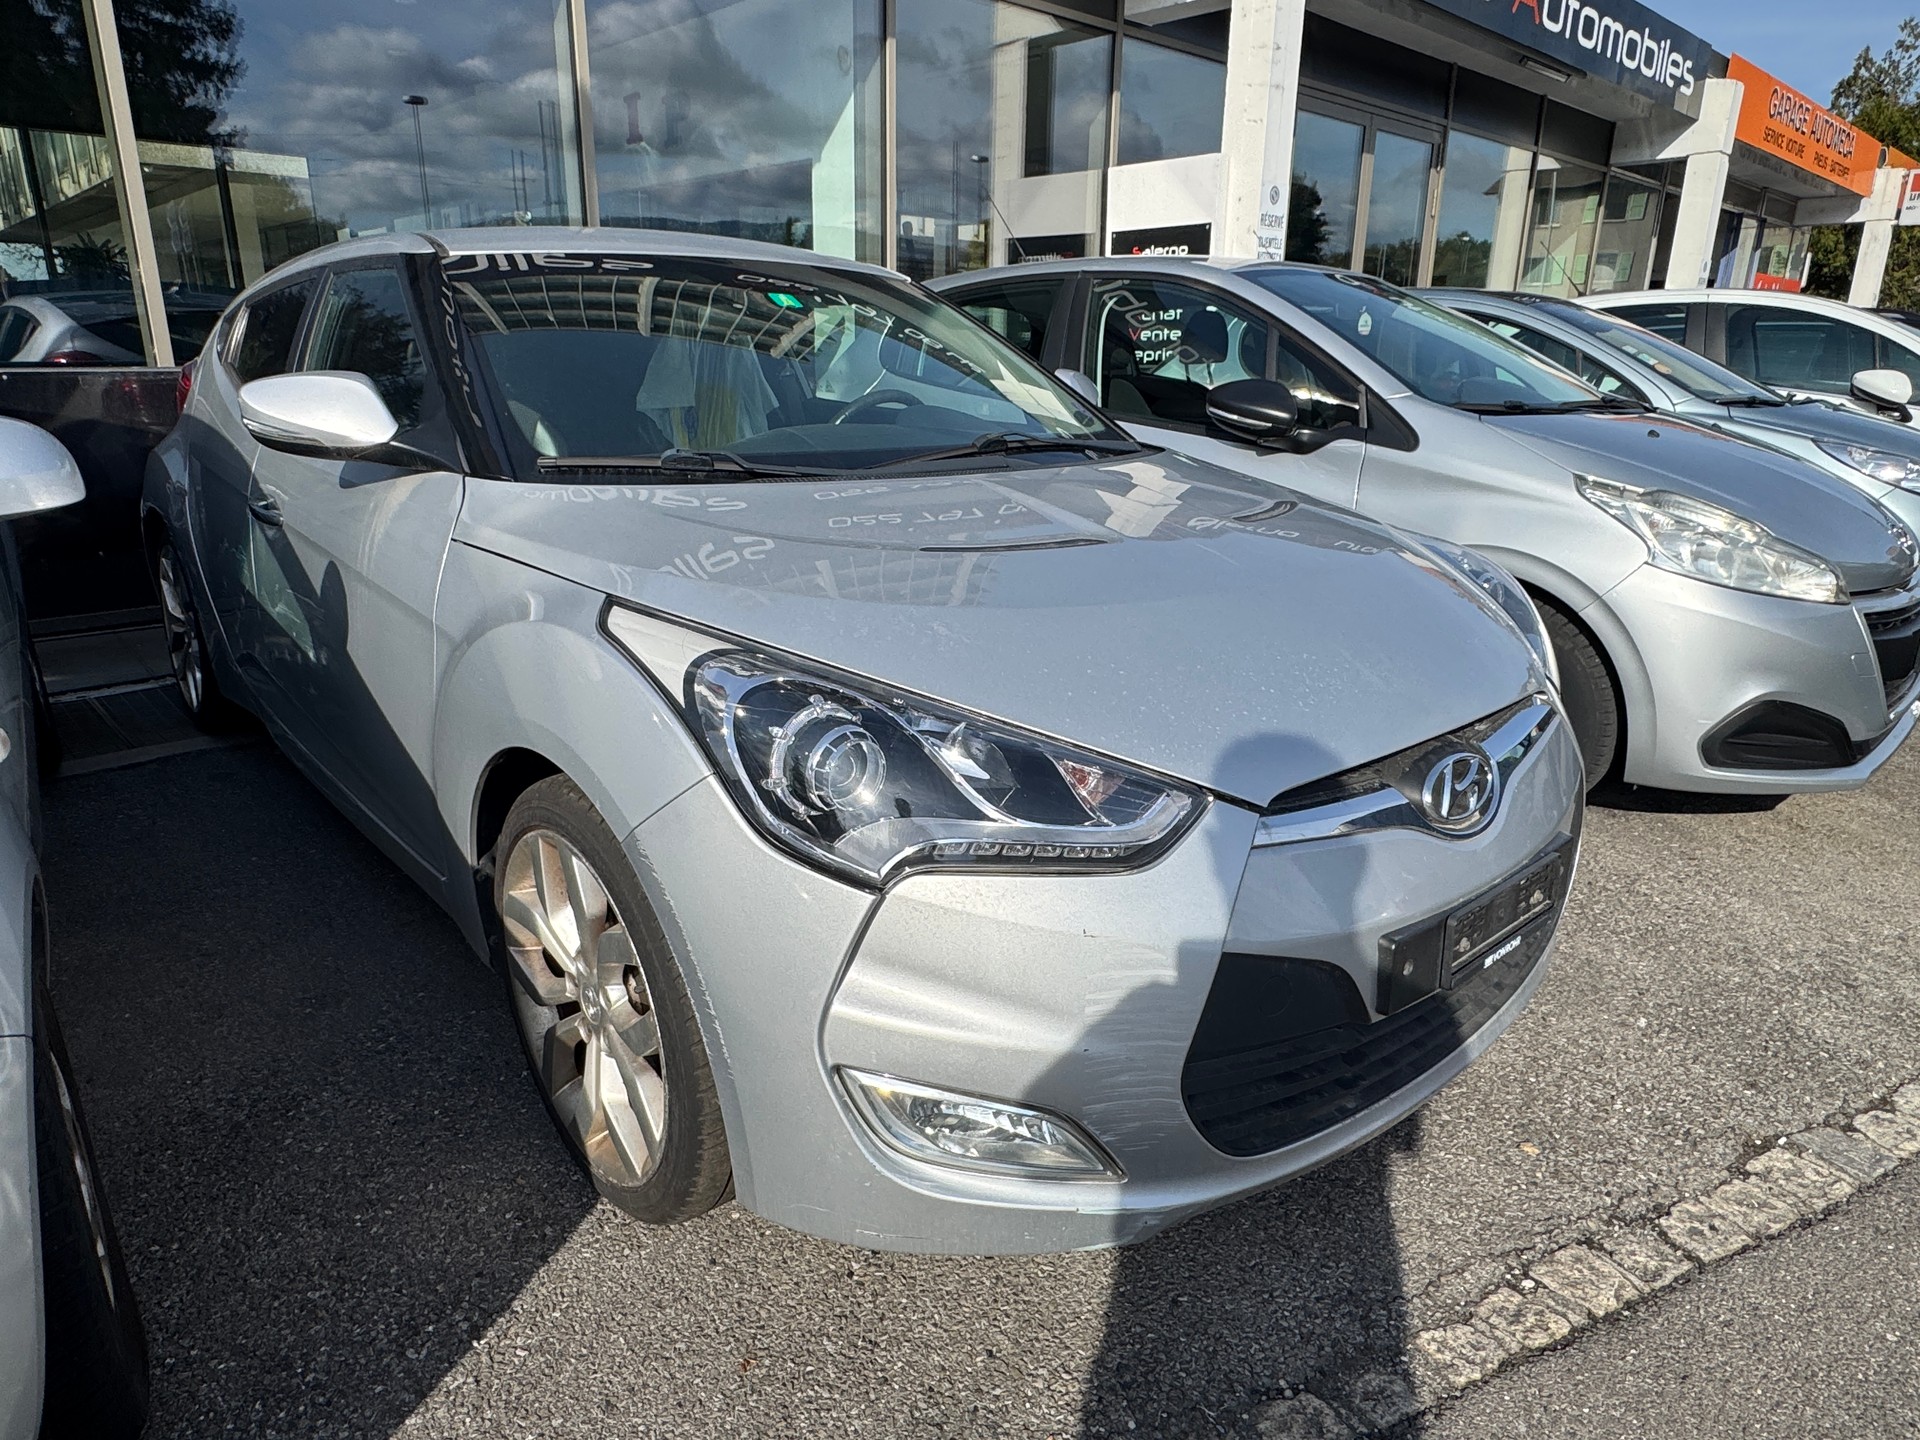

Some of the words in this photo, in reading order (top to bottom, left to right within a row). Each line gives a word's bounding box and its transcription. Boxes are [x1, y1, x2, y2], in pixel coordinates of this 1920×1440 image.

[1768, 86, 1811, 137] GARAGE
[1763, 126, 1786, 150] SERVICE
[1131, 244, 1189, 256] Salerno
[1128, 328, 1182, 342] Vente
